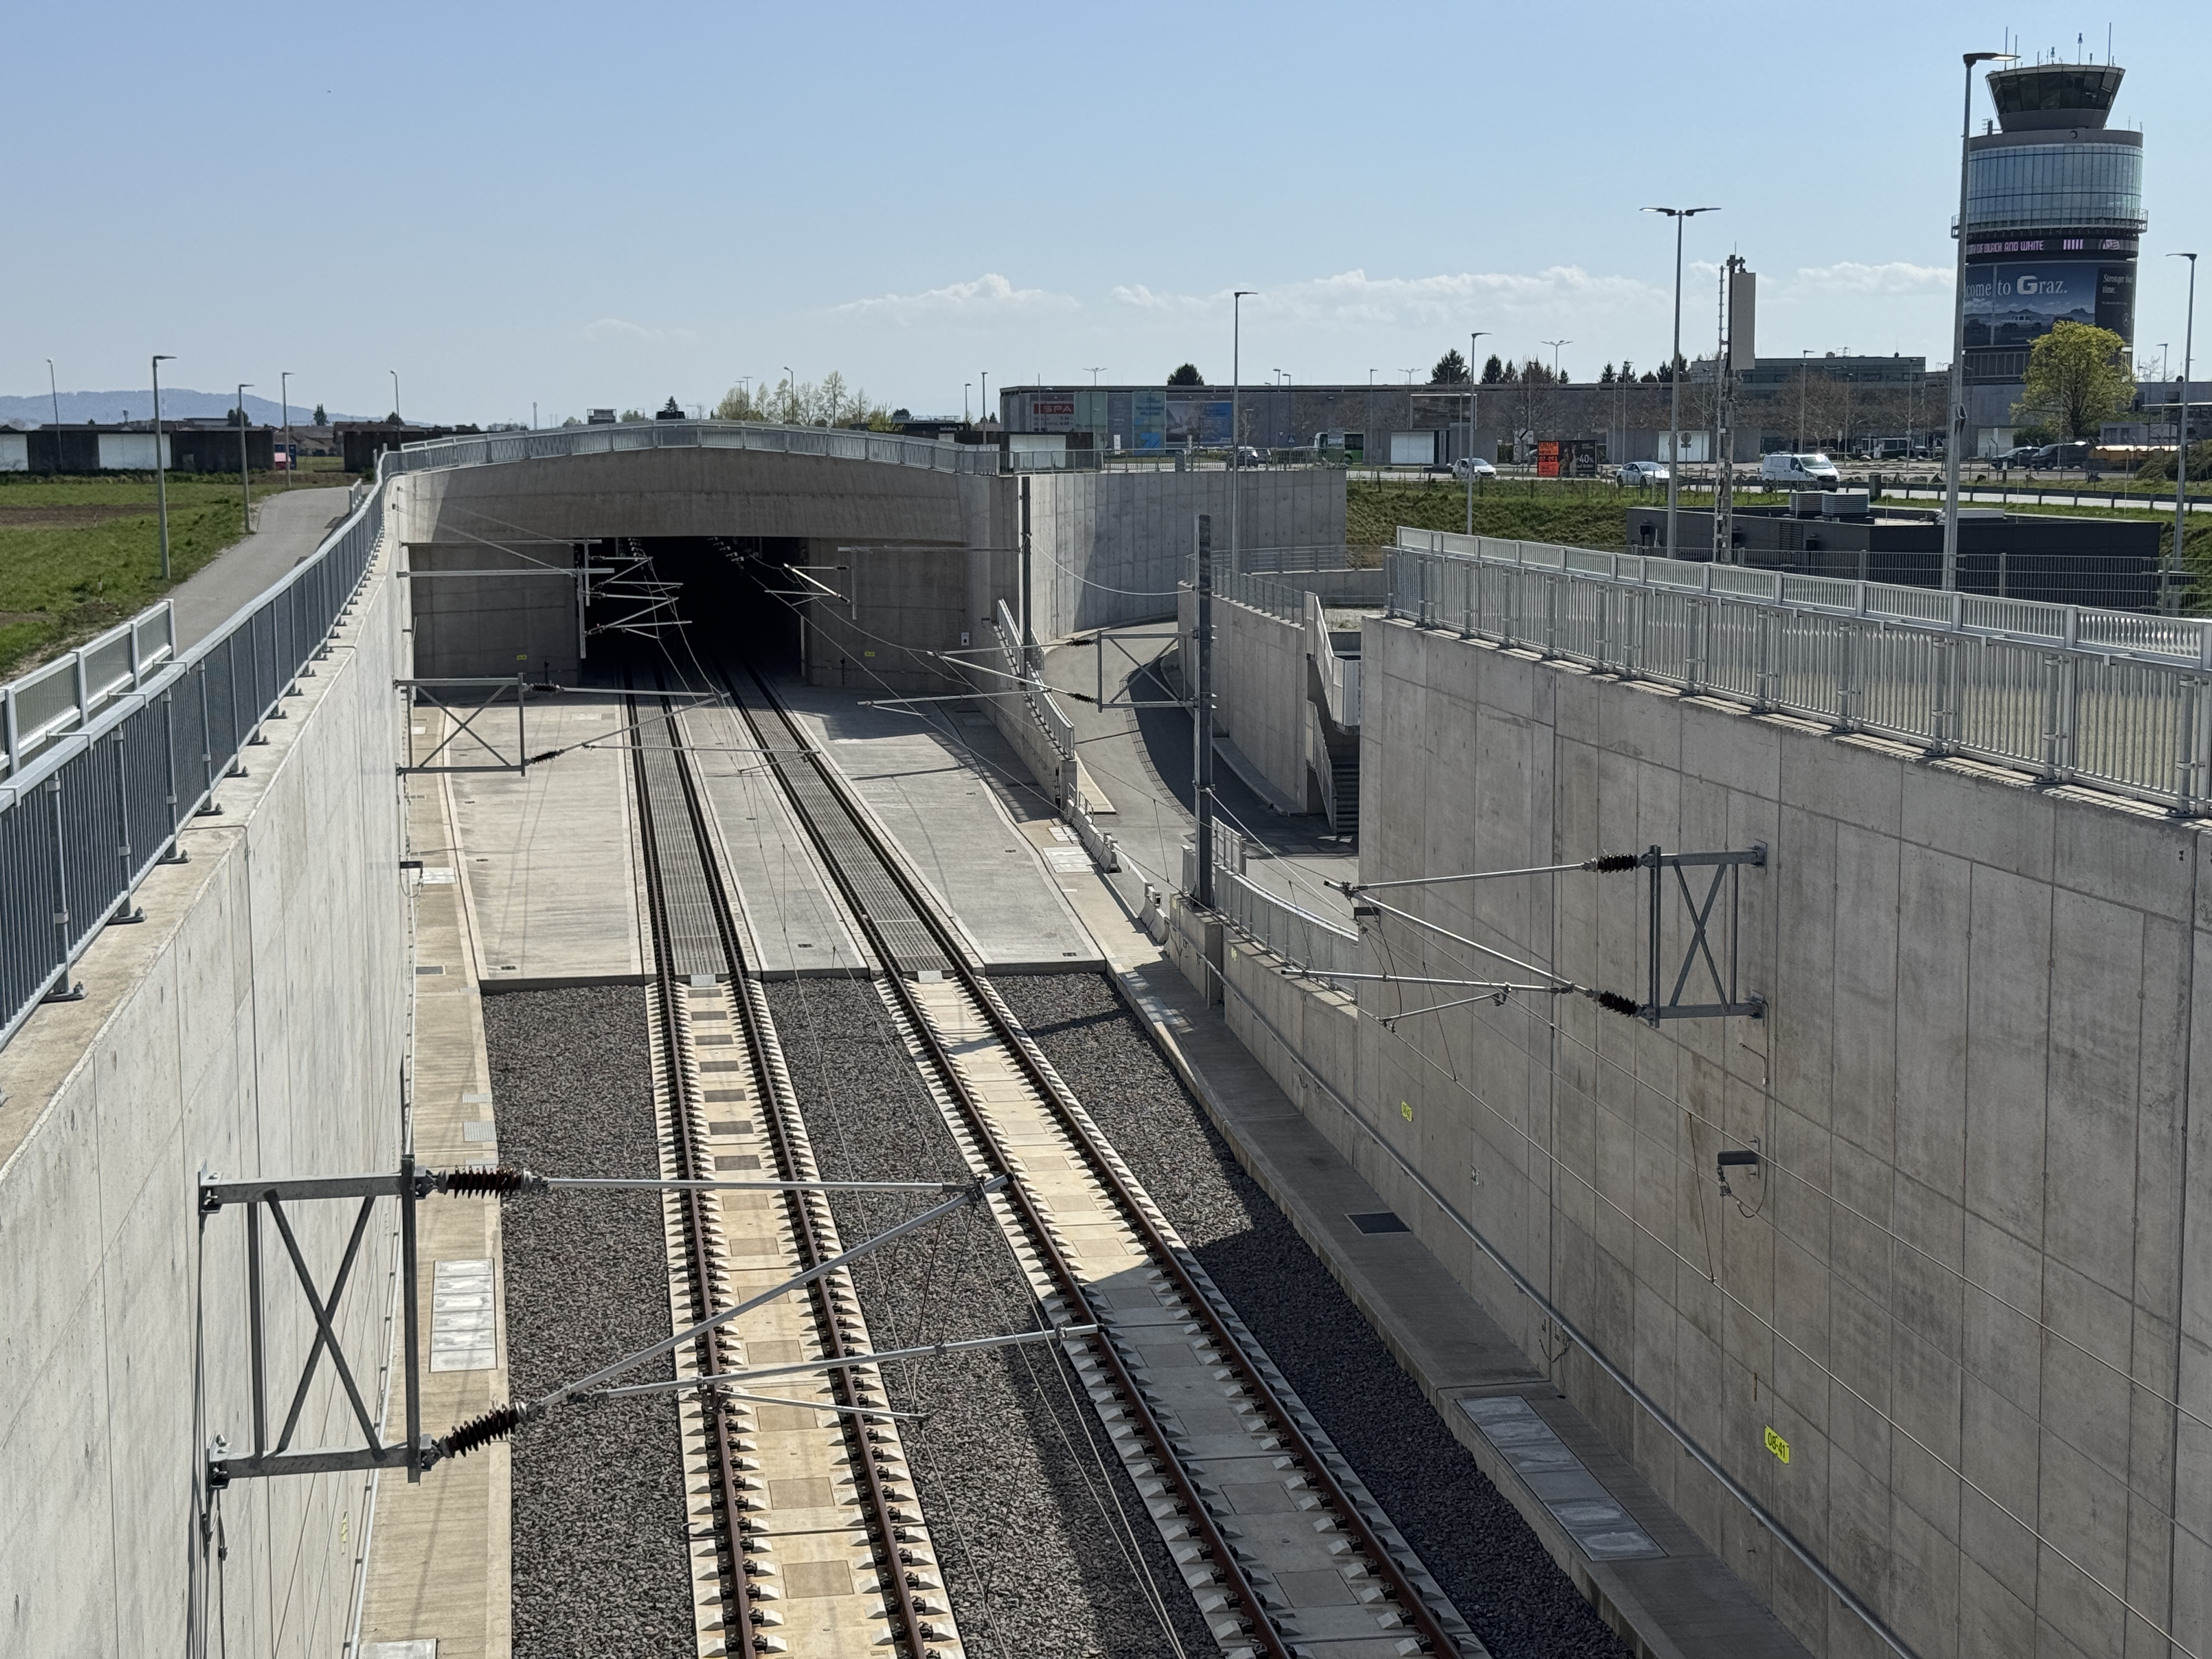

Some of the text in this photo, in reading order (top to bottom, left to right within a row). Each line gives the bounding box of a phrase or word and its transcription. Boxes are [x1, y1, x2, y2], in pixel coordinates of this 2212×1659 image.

[1984, 242, 2002, 253] BLACK
[2004, 241, 2018, 252] AND
[2020, 240, 2044, 251] WHITE
[1964, 275, 2068, 298] lcome to Graz.
[1768, 1431, 1785, 1459] 08-41
